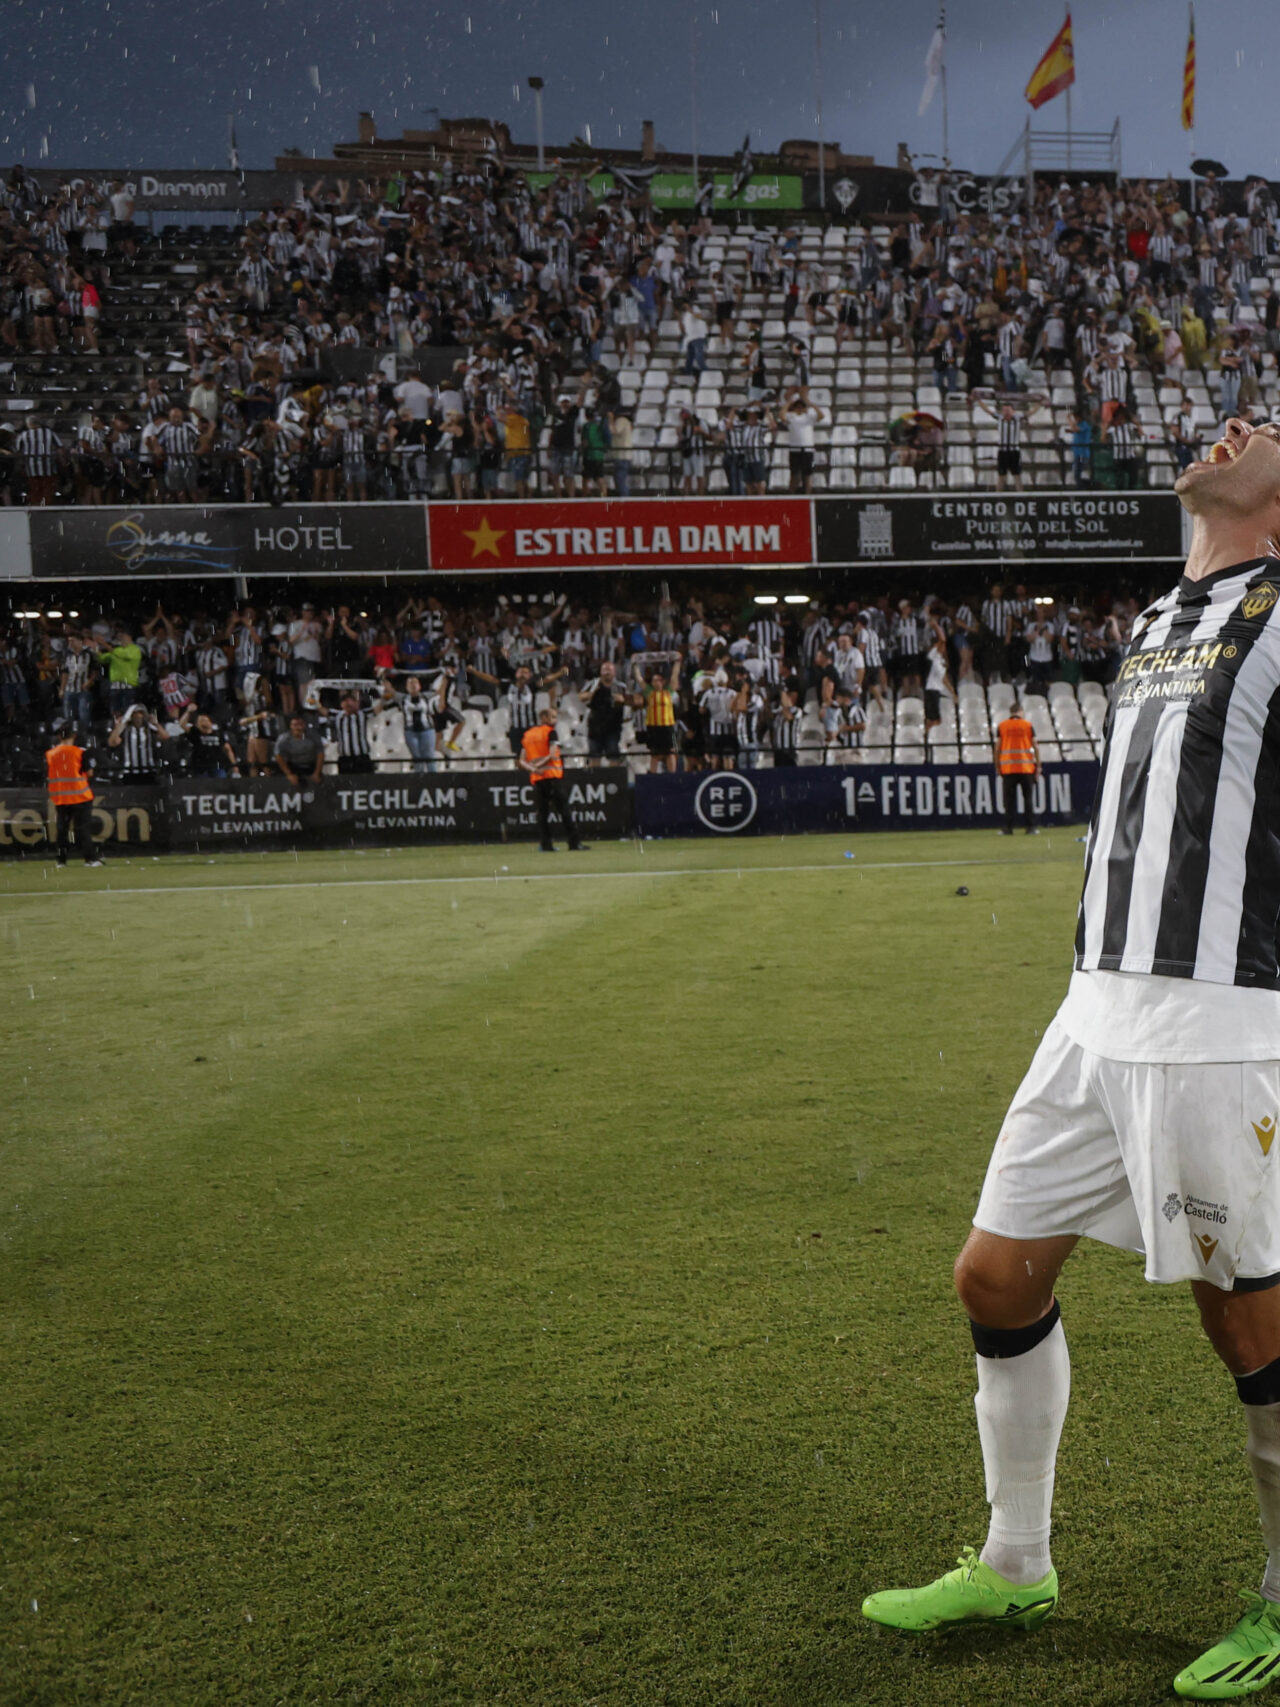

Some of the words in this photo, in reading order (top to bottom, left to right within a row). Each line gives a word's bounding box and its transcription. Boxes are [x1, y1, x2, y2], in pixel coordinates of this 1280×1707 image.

[932, 502, 1007, 518] CENTRO
[1014, 502, 1037, 517] DE
[1047, 500, 1140, 516] NEGOCIOS
[966, 519, 1033, 535] PUERTA
[1038, 520, 1071, 534] DEL
[254, 527, 353, 550] HOTEL
[514, 526, 673, 556] ESTRELLA
[679, 525, 781, 552] DAMM
[213, 819, 303, 834] LEVANTINA
[367, 815, 456, 829] LEVANTINA
[1186, 1194, 1218, 1209] Ajuntament
[1220, 1204, 1228, 1212] de
[1184, 1203, 1227, 1224] Castelló
